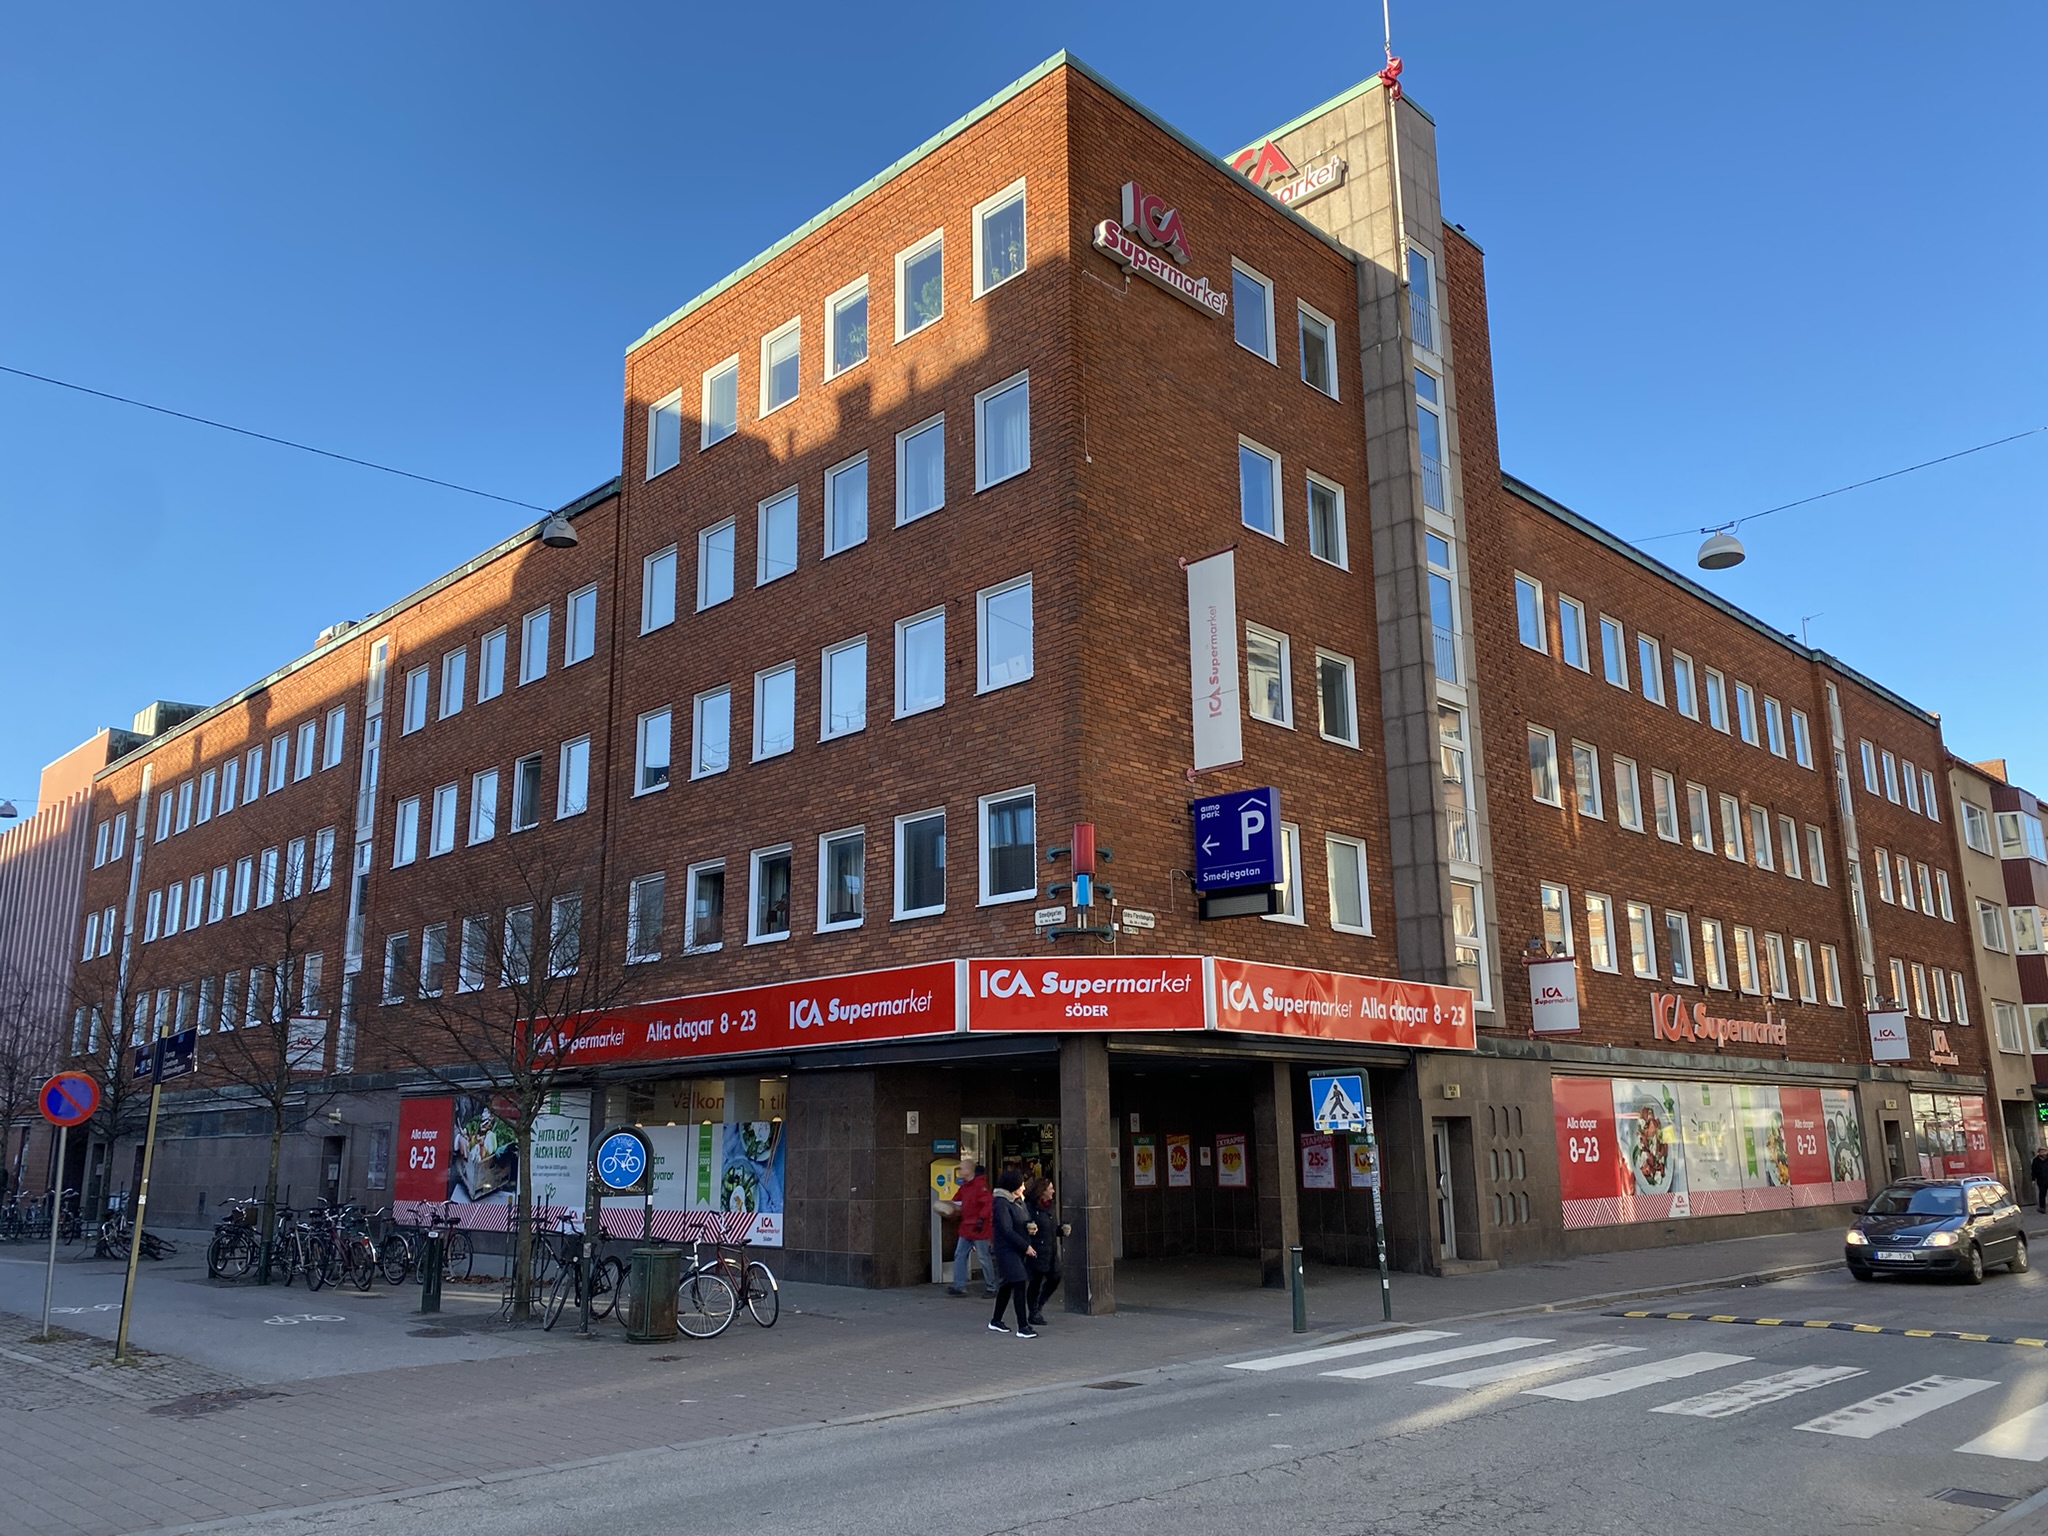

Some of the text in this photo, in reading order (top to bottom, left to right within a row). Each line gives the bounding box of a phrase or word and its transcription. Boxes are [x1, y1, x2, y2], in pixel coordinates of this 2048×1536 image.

[1231, 139, 1293, 185] CA
[1122, 180, 1193, 264] ICA
[1103, 221, 1228, 316] Supermarket
[1208, 604, 1222, 718] ICA Supermarket
[1200, 810, 1220, 821] park
[1240, 810, 1265, 851] P
[1203, 867, 1261, 882] Smedjegatan
[979, 969, 1192, 998] ICA Supermarket
[1534, 996, 1575, 1005] Supermarket
[1541, 987, 1563, 999] ICA
[789, 988, 933, 1030] ICA Supermarket
[1065, 1003, 1109, 1017] SÖDER
[1221, 979, 1260, 1013] ICA
[1262, 986, 1353, 1018] Supermarket
[1360, 996, 1387, 1020] Alla
[1389, 999, 1428, 1028] dagar
[1433, 1003, 1442, 1025] 8
[1451, 1005, 1466, 1026] 23
[646, 1020, 671, 1043] Alla
[673, 1017, 714, 1043] dagar
[719, 1012, 729, 1034] 8
[740, 1008, 757, 1032] 23
[1650, 991, 1787, 1048] ICA Supermarket
[1879, 1029, 1896, 1037] ICA
[1566, 1116, 1597, 1132] Alla dagar
[410, 1128, 439, 1142] Alla dagar
[537, 1127, 570, 1142] HITTA EKO
[533, 1145, 572, 1159] ÄLSKA VEGO
[761, 1217, 774, 1228] ICA
